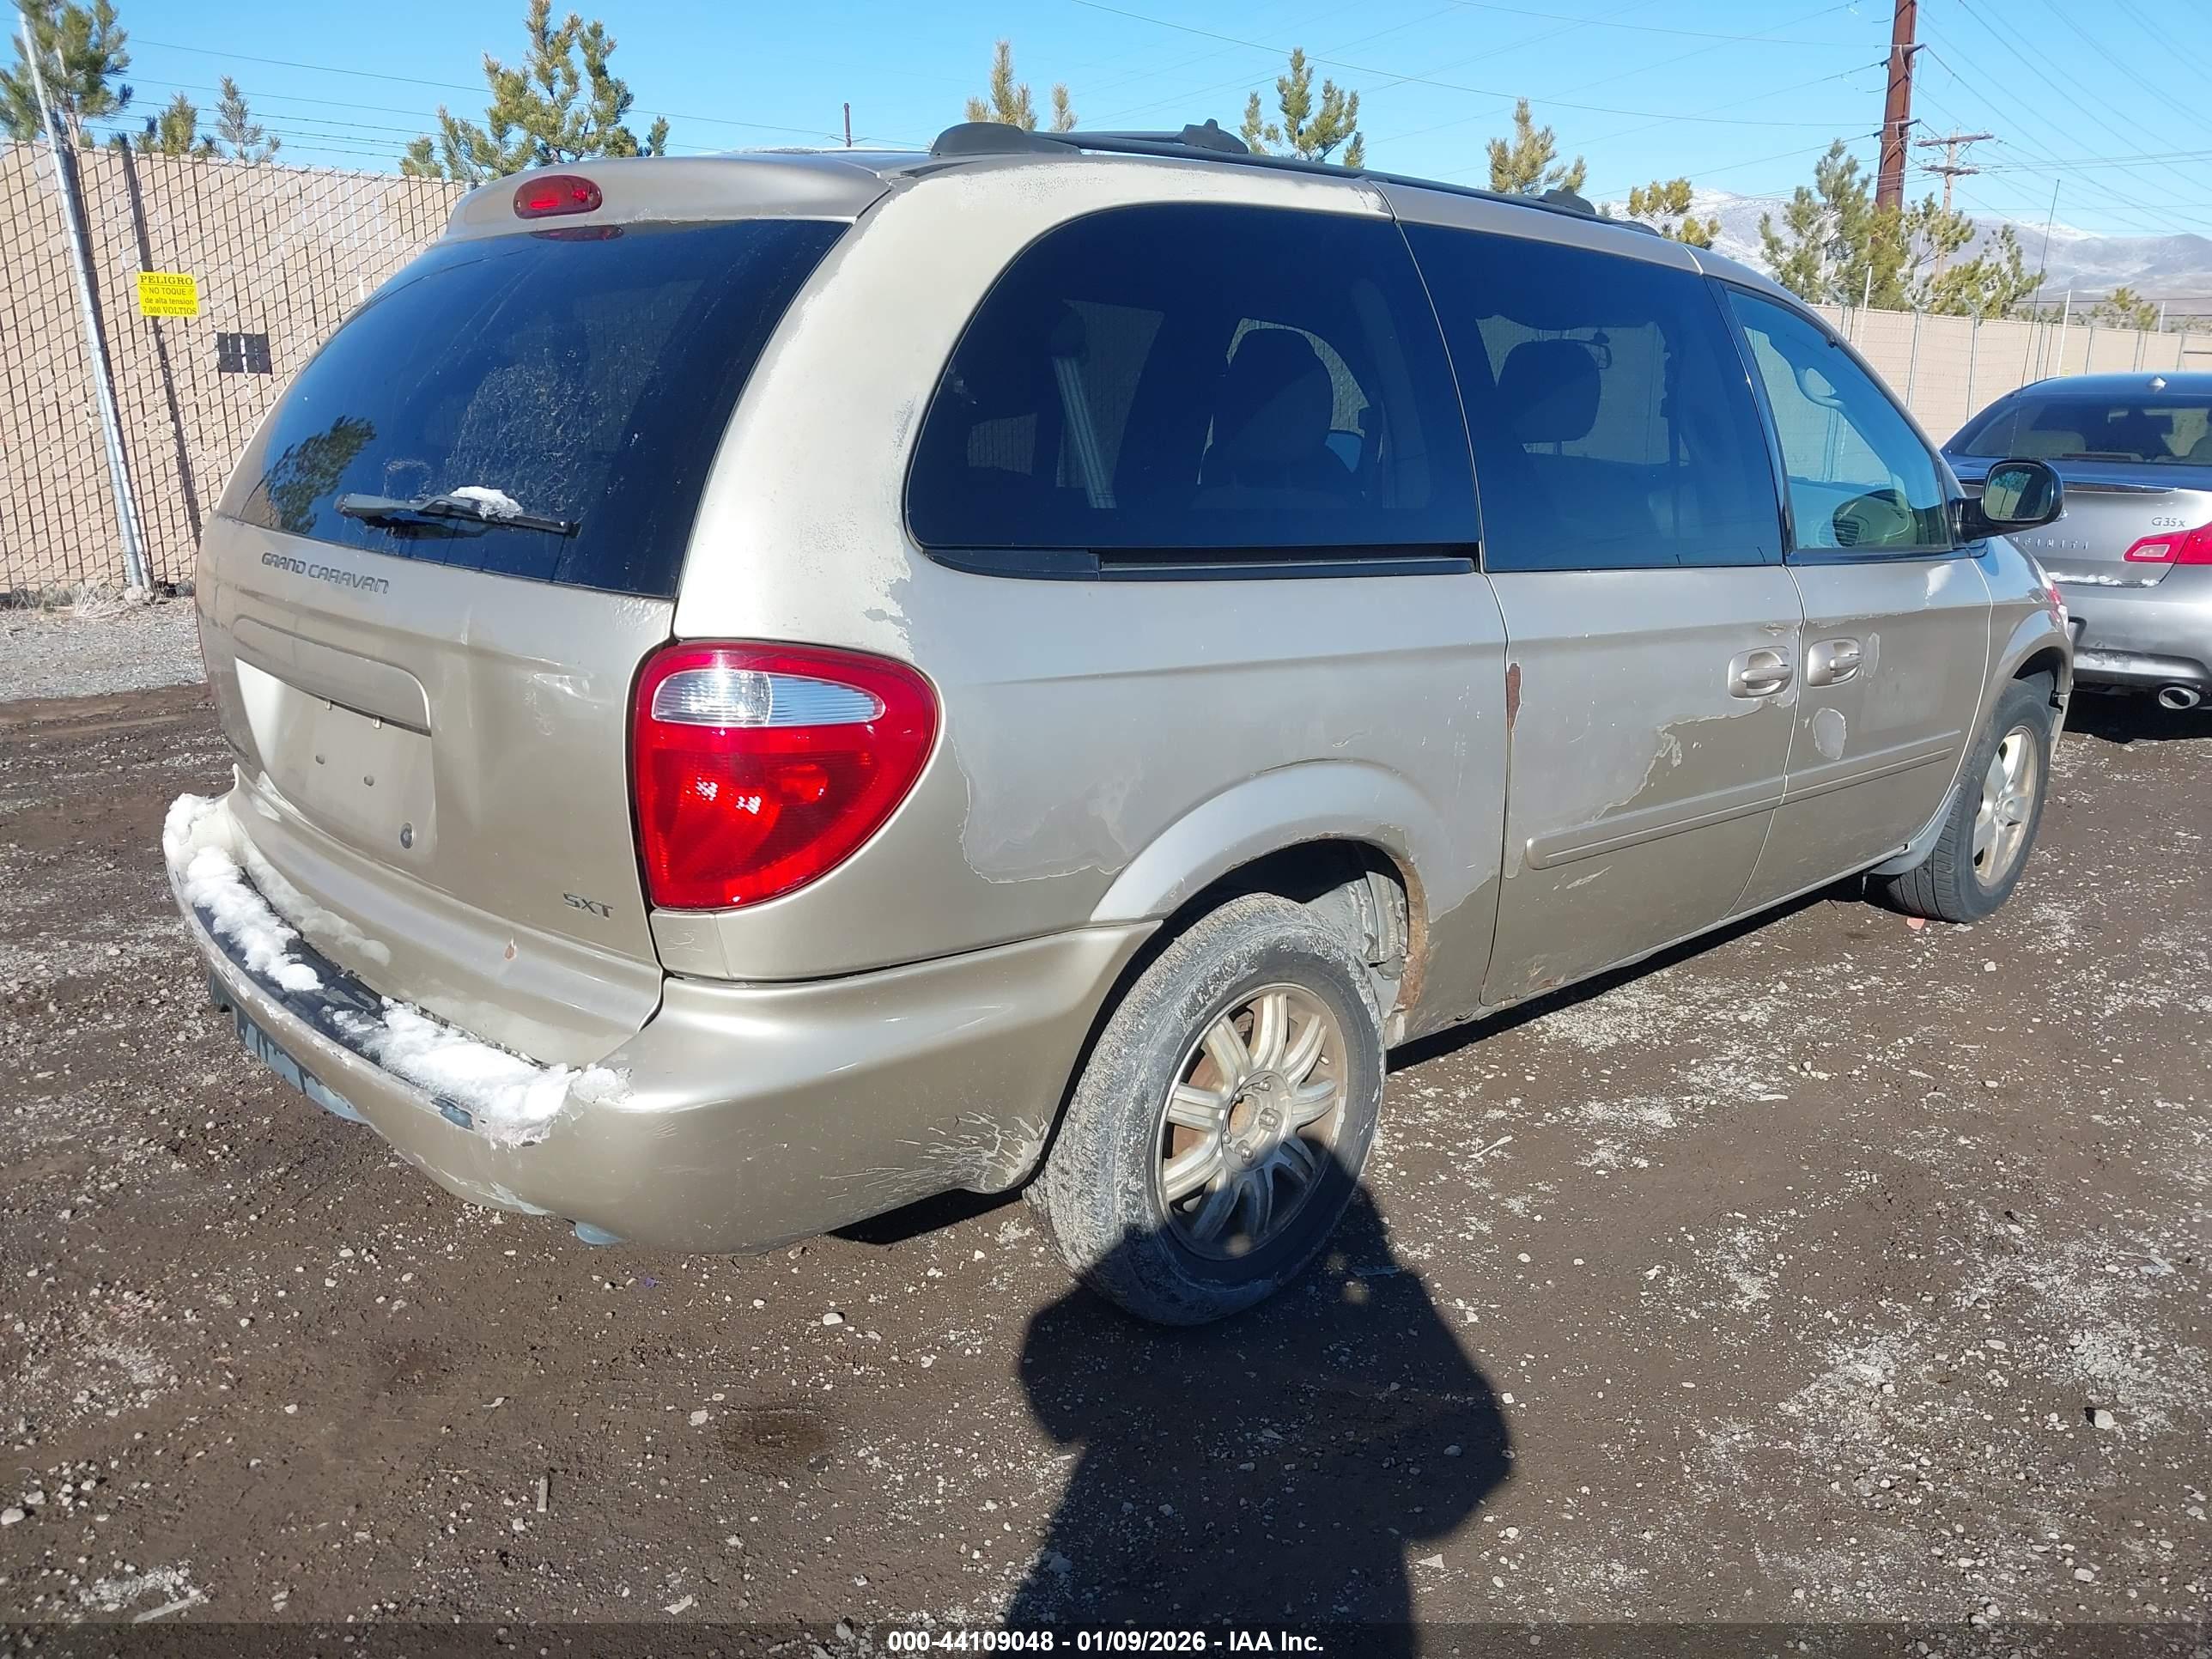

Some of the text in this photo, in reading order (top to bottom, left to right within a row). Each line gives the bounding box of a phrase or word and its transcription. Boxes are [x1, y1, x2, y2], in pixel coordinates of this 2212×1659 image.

[140, 275, 193, 285] PELIGRO
[163, 307, 197, 315] VOLTIOS
[2013, 536, 2088, 550] NFINITI
[261, 551, 390, 594] GRAND CARAVAN
[563, 892, 614, 919] SXT
